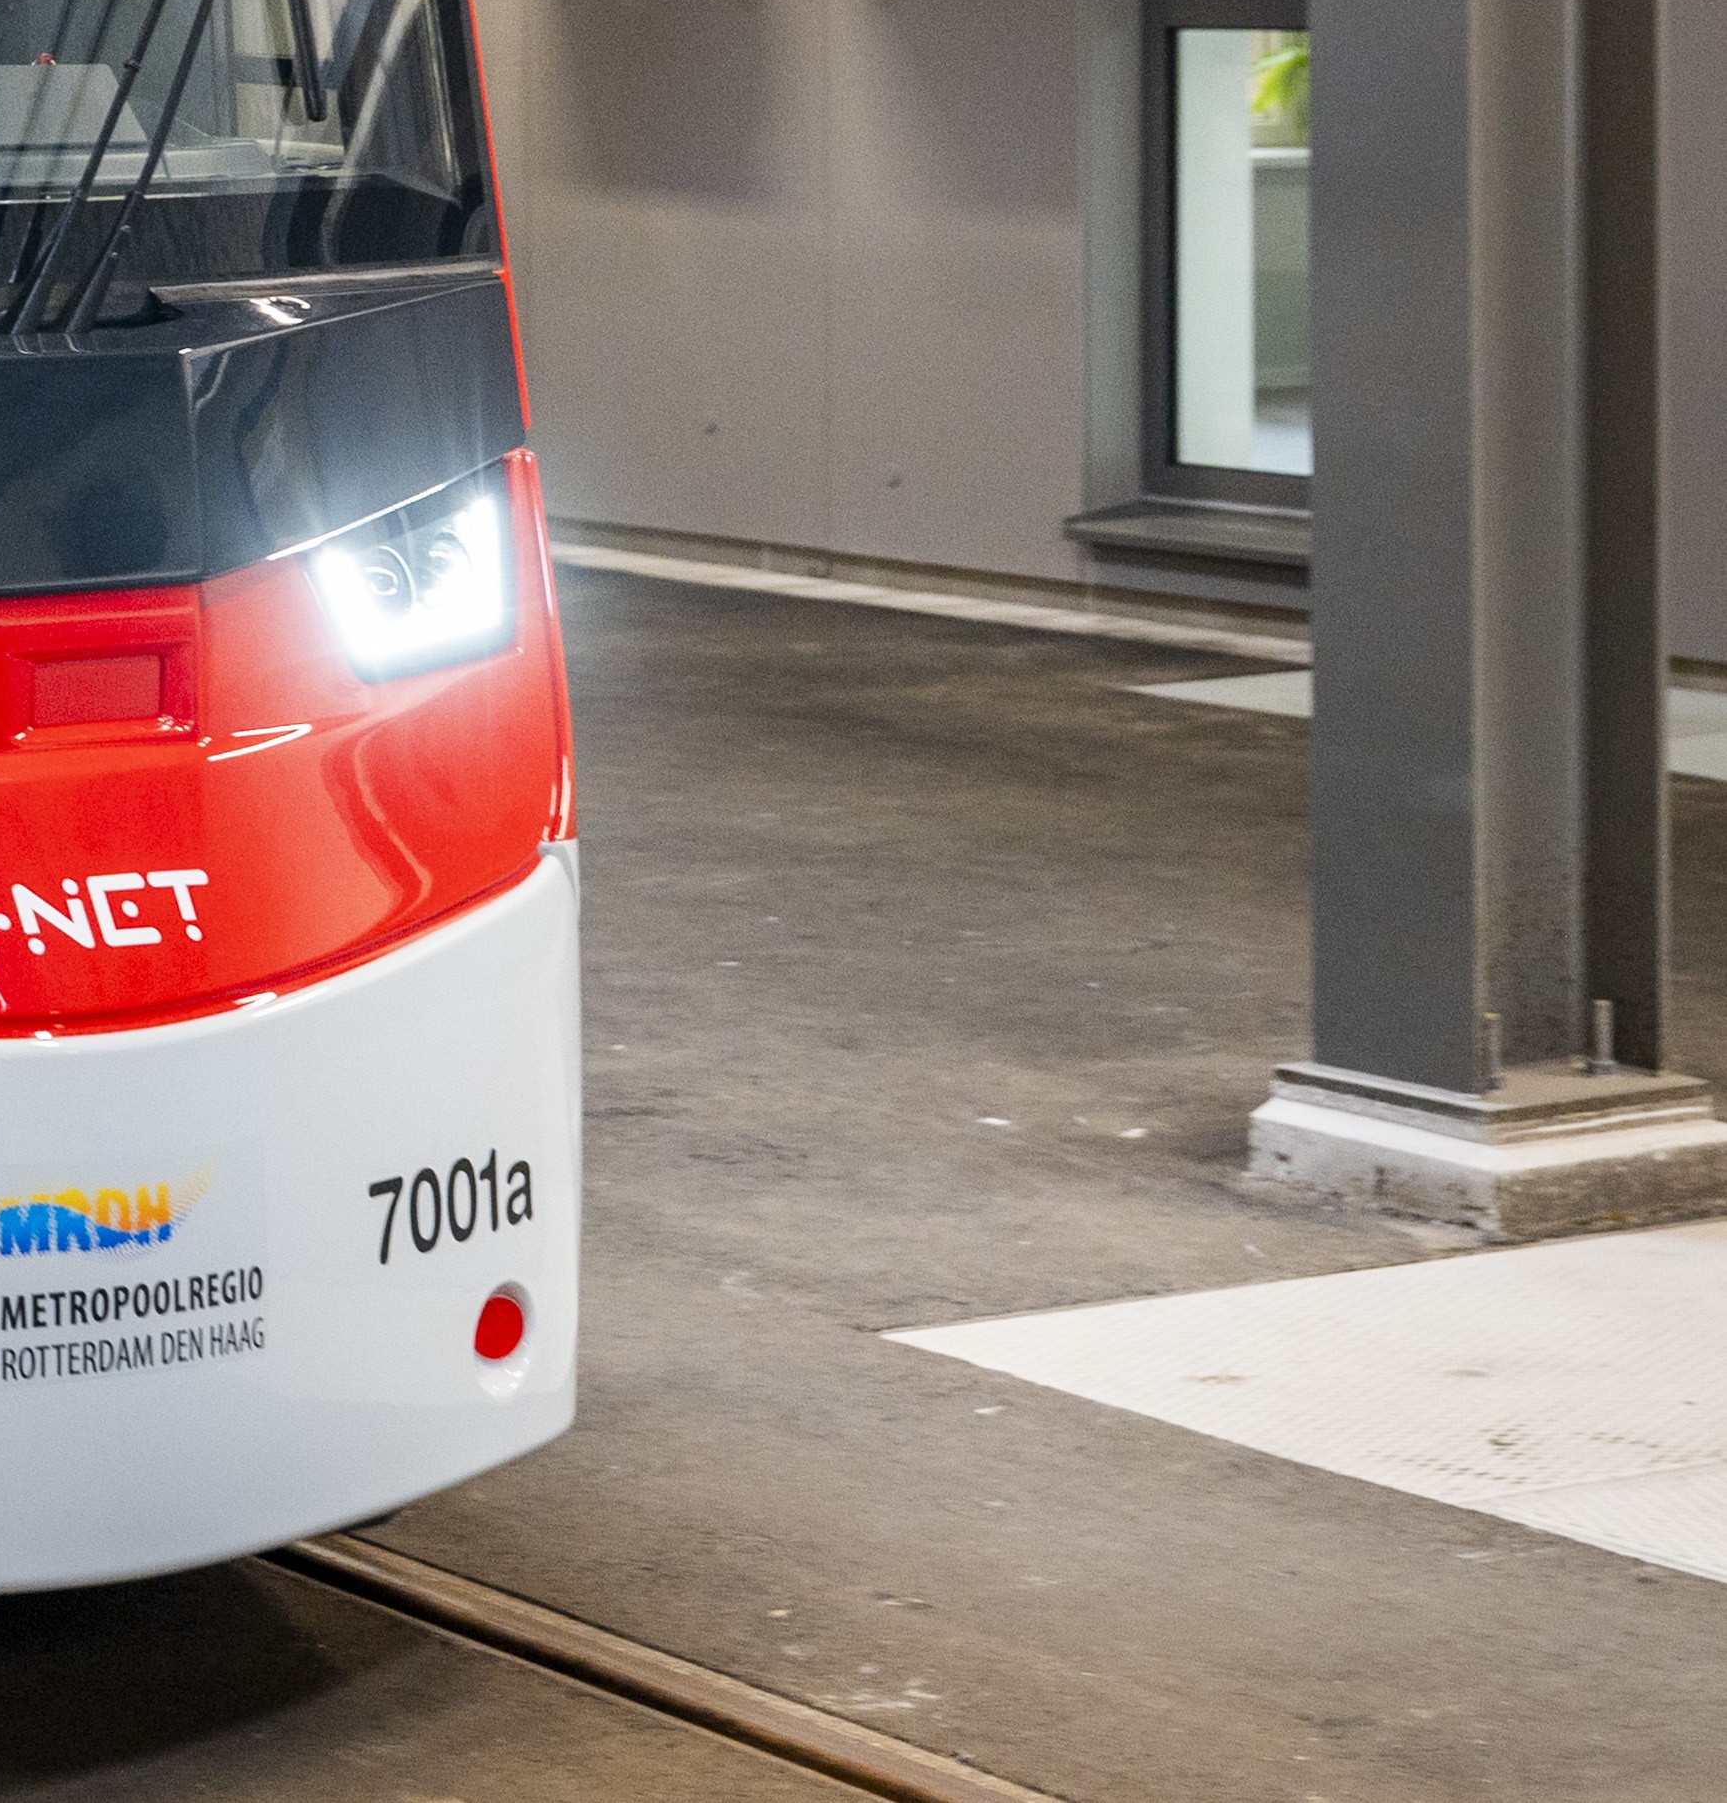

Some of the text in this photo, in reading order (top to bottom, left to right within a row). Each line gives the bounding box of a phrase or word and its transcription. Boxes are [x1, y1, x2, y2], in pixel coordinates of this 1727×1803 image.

[368, 1146, 533, 1265] 7001a
[0, 1265, 264, 1332] METROPOOLREGIO
[0, 1316, 266, 1382] ROTTERDAM DEN HAAG
